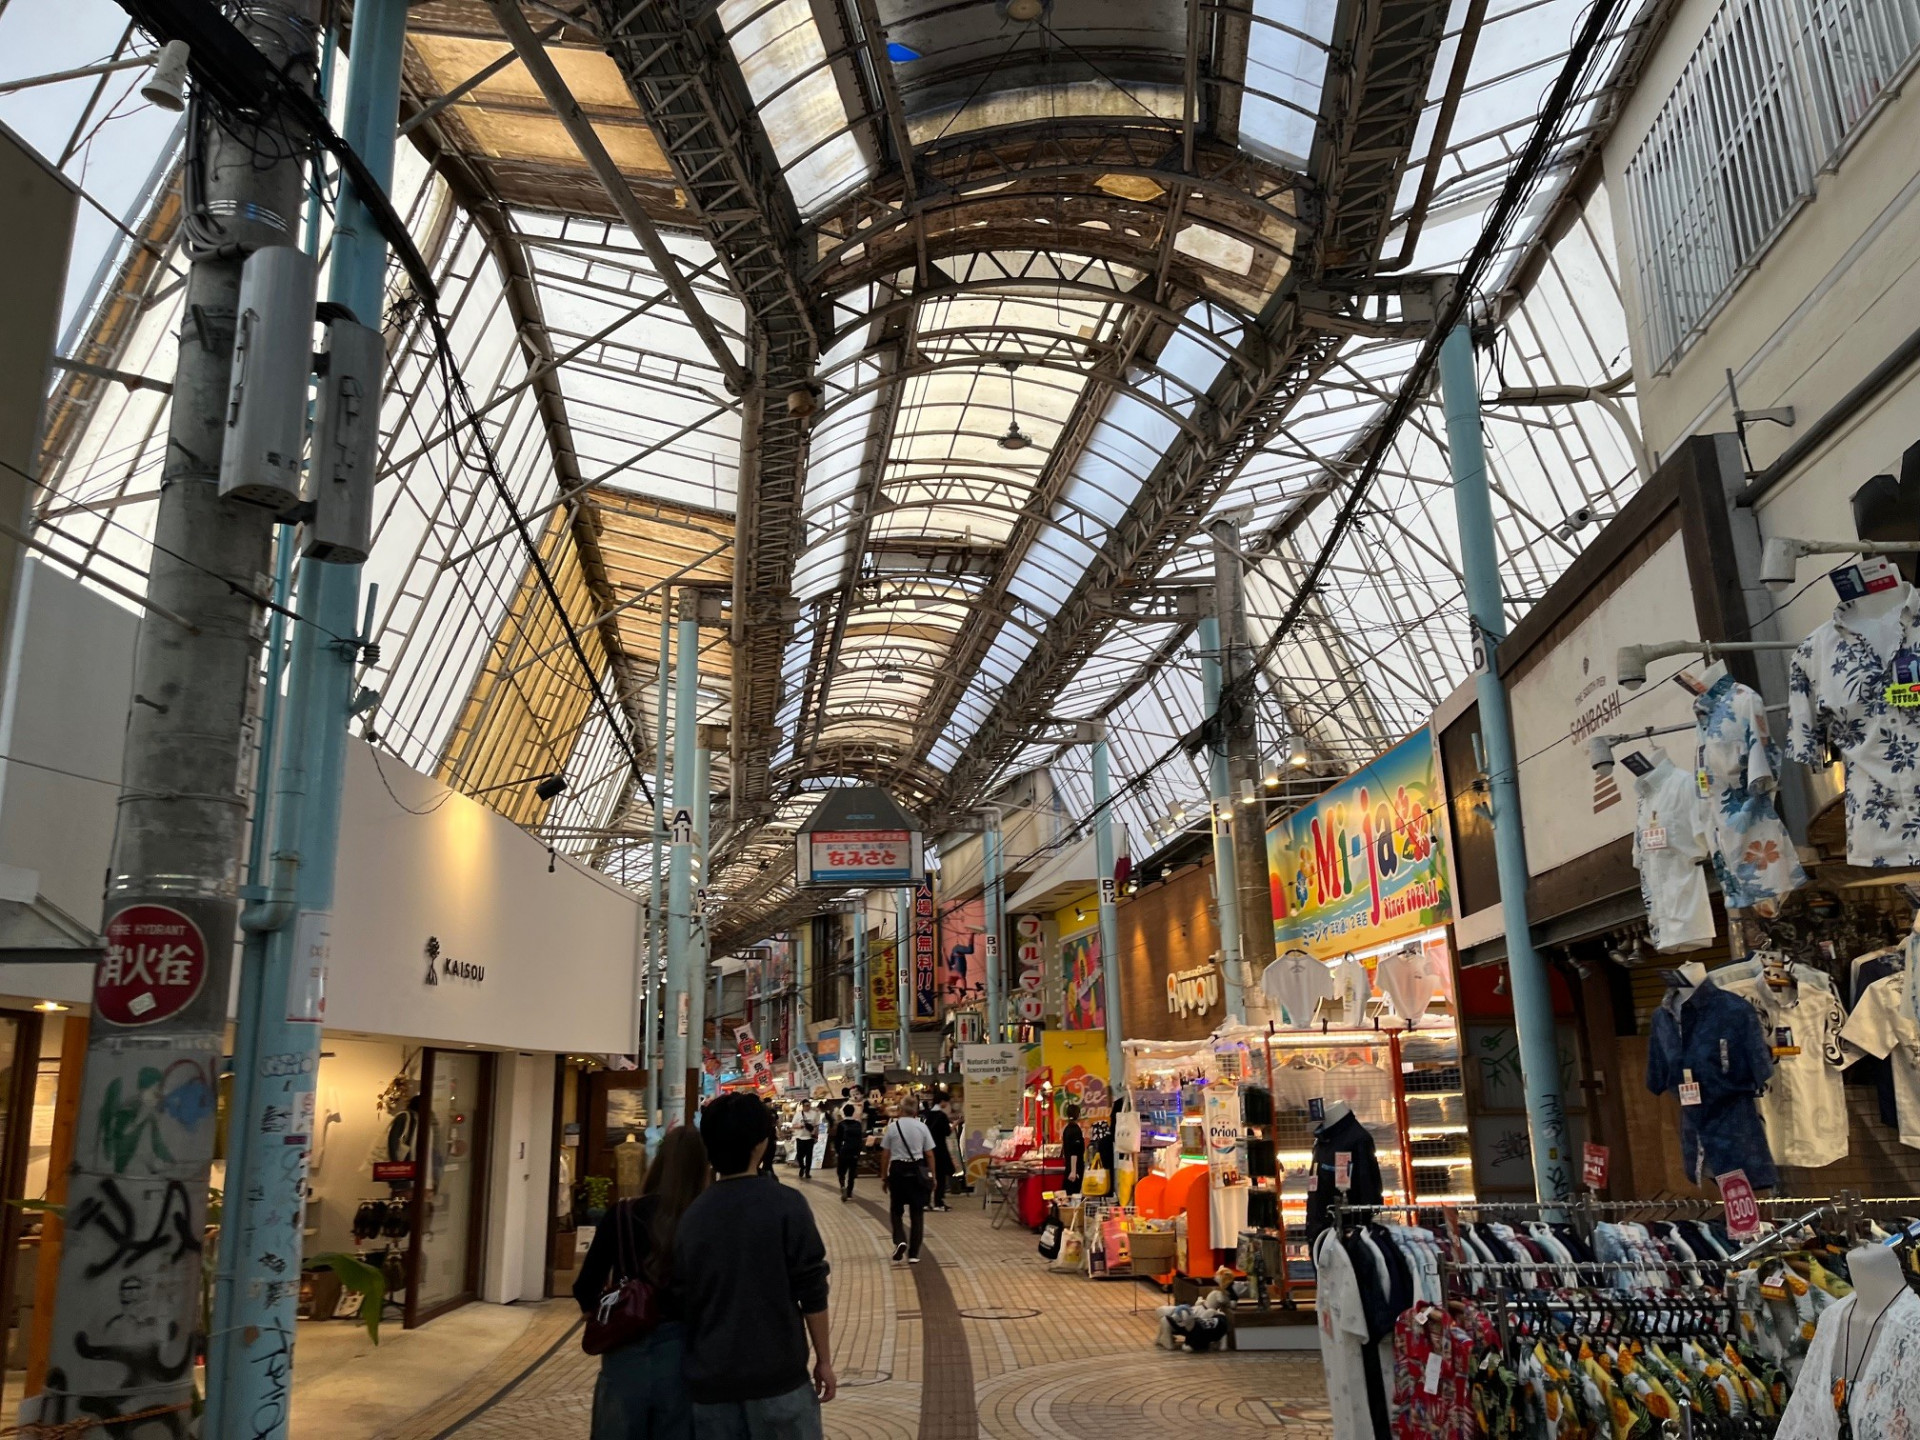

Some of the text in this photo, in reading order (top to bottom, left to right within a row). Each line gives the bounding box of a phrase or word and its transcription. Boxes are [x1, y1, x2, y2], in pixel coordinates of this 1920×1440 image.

[1570, 690, 1622, 745] SANBASHI
[673, 810, 692, 825] A
[674, 828, 690, 842] 11
[827, 850, 897, 866] なみさと
[1102, 880, 1114, 891] B
[697, 889, 706, 900] A
[1103, 892, 1115, 903] 12
[1383, 896, 1405, 919] Since
[134, 924, 187, 936] HYDRANT
[987, 946, 997, 955] 13
[98, 942, 195, 987] 消火栓
[444, 957, 485, 982] KAISOU
[1021, 920, 1042, 1018] フルマリ
[1059, 1100, 1112, 1121] Ceam
[1210, 1124, 1237, 1138] Orion
